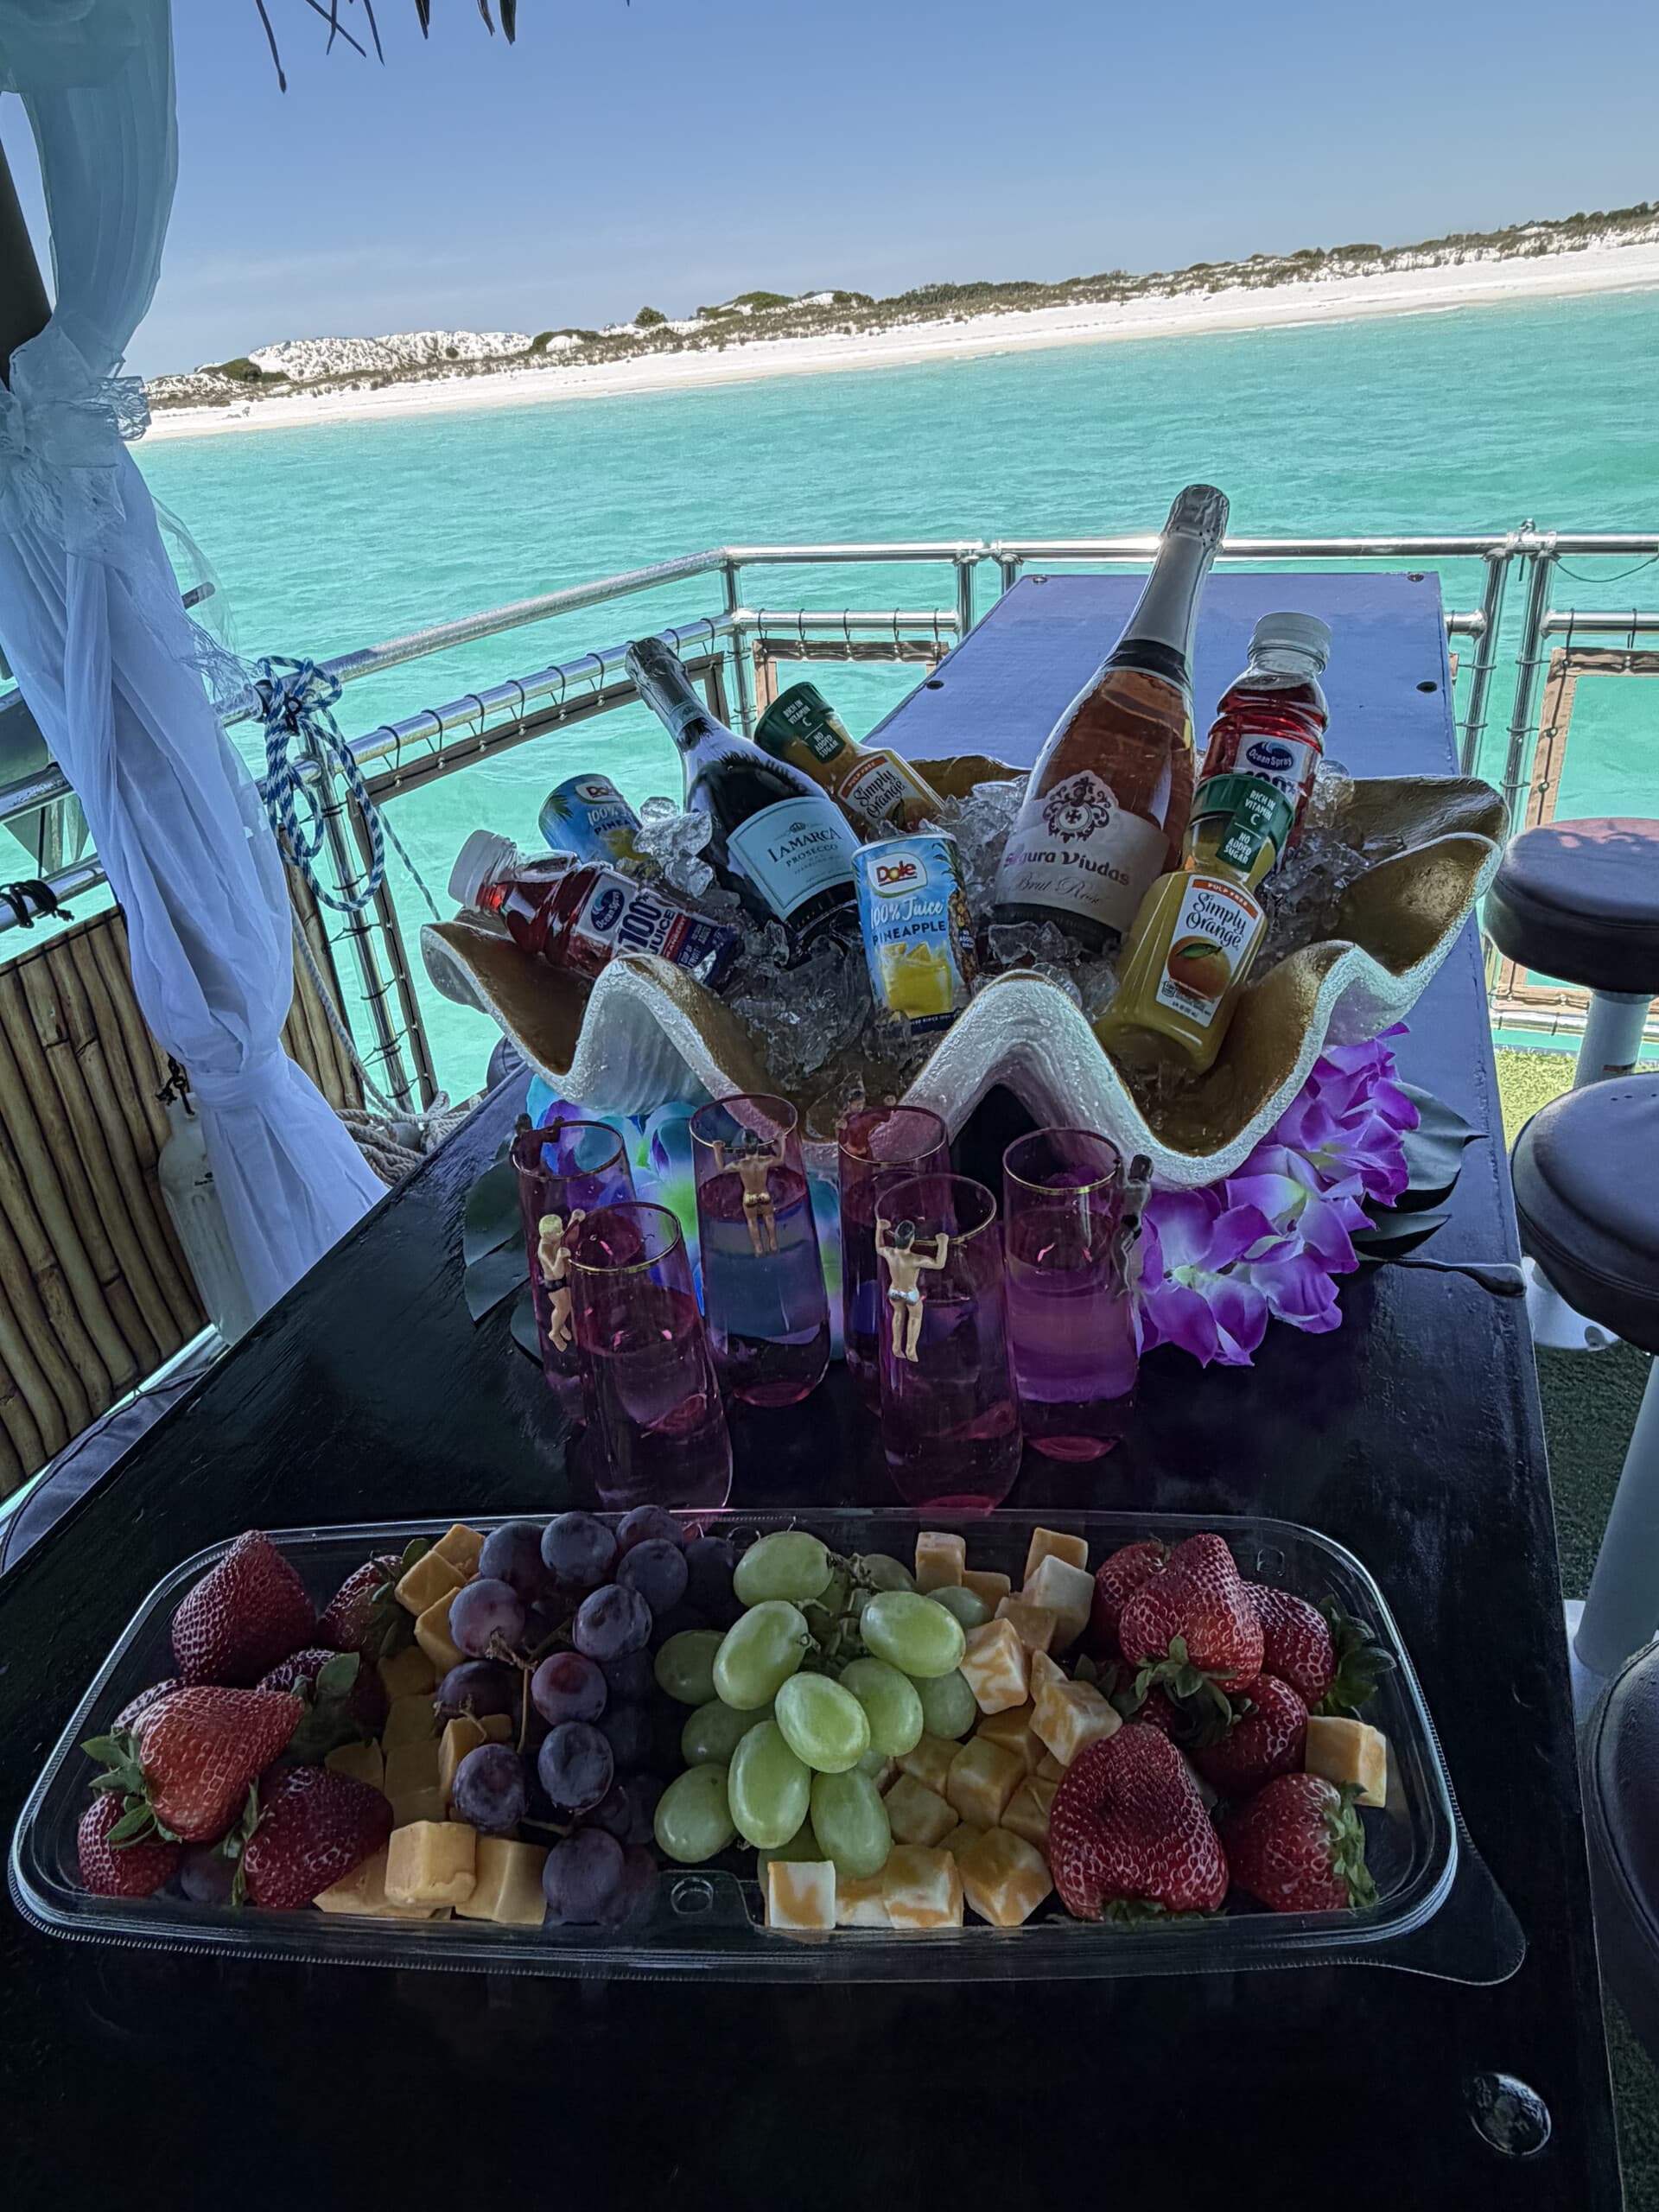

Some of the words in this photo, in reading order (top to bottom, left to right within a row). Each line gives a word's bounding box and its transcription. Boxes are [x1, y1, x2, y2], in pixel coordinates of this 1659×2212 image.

[782, 702, 799, 719] RICH
[788, 705, 811, 725] VITAMIN
[802, 718, 812, 728] C
[814, 732, 824, 741] NO
[814, 734, 834, 752] ADDED
[819, 741, 839, 758] SUGAR
[1249, 748, 1271, 765] Ocean
[1270, 755, 1292, 767] Spray
[853, 768, 900, 807] Simply
[866, 779, 906, 818] Orange
[1244, 798, 1274, 821] VITAMIN
[1249, 790, 1268, 804] RICH
[1268, 799, 1276, 810] IN
[1250, 813, 1261, 826] C
[1228, 837, 1252, 855] ADDED
[1239, 831, 1251, 843] NO
[785, 843, 839, 868] PROSECCO
[1224, 844, 1249, 865] SUGAR
[875, 860, 917, 882] Dole
[1061, 851, 1130, 886] Viudas
[1014, 871, 1052, 893] Brut
[1208, 882, 1230, 893] PULP
[1230, 891, 1249, 906] FREE
[596, 904, 614, 929] Ocean
[608, 890, 621, 911] Spray
[870, 903, 900, 930] 100%
[901, 896, 944, 921] Juice
[1193, 893, 1247, 934] Simply
[618, 894, 662, 949] 100%
[648, 909, 676, 955] JUICE
[1185, 912, 1243, 948] Orange
[872, 920, 947, 946] PINEAPPLE
